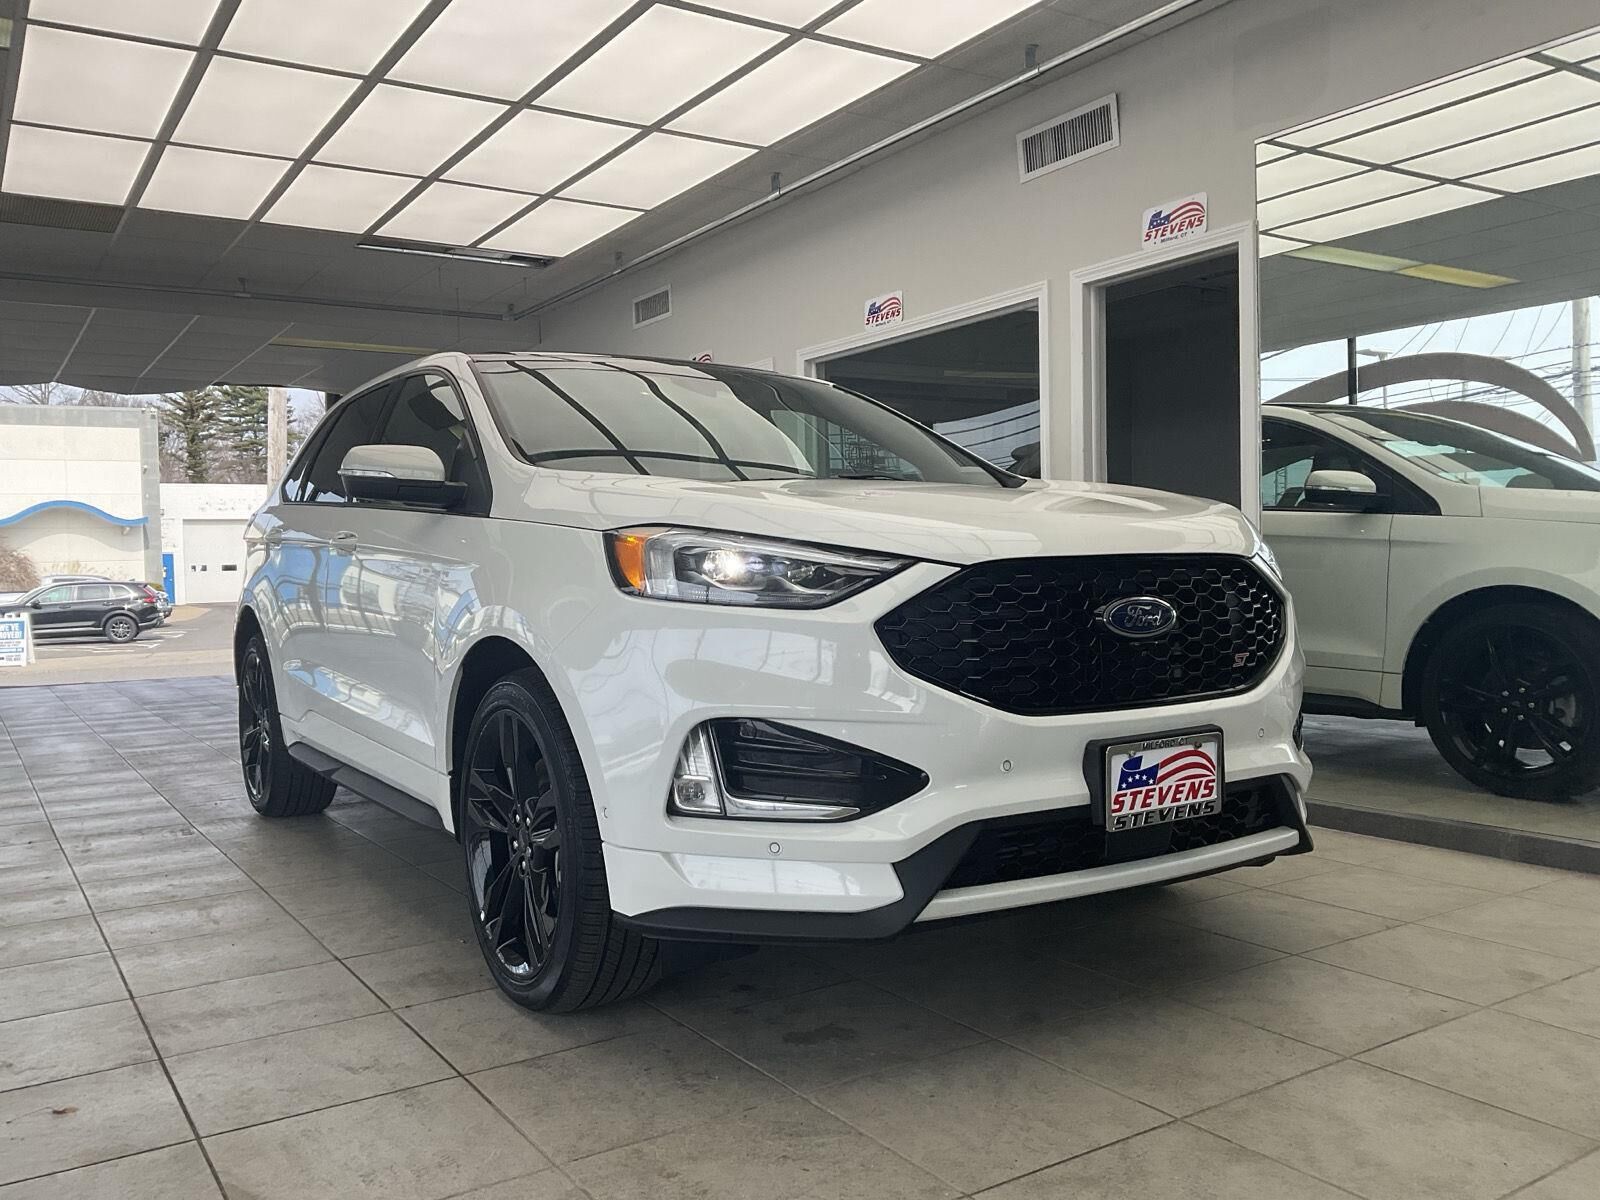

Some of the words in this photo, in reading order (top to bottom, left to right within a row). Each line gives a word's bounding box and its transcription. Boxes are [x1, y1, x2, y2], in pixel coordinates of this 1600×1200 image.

[1144, 215, 1205, 242] STEVENS
[866, 308, 901, 325] STEVENS
[1123, 604, 1163, 628] Ford
[1232, 652, 1250, 668] ST
[1142, 738, 1176, 751] MILFORD
[1111, 778, 1216, 814] STEVENS
[1113, 800, 1217, 831] STEVENS
